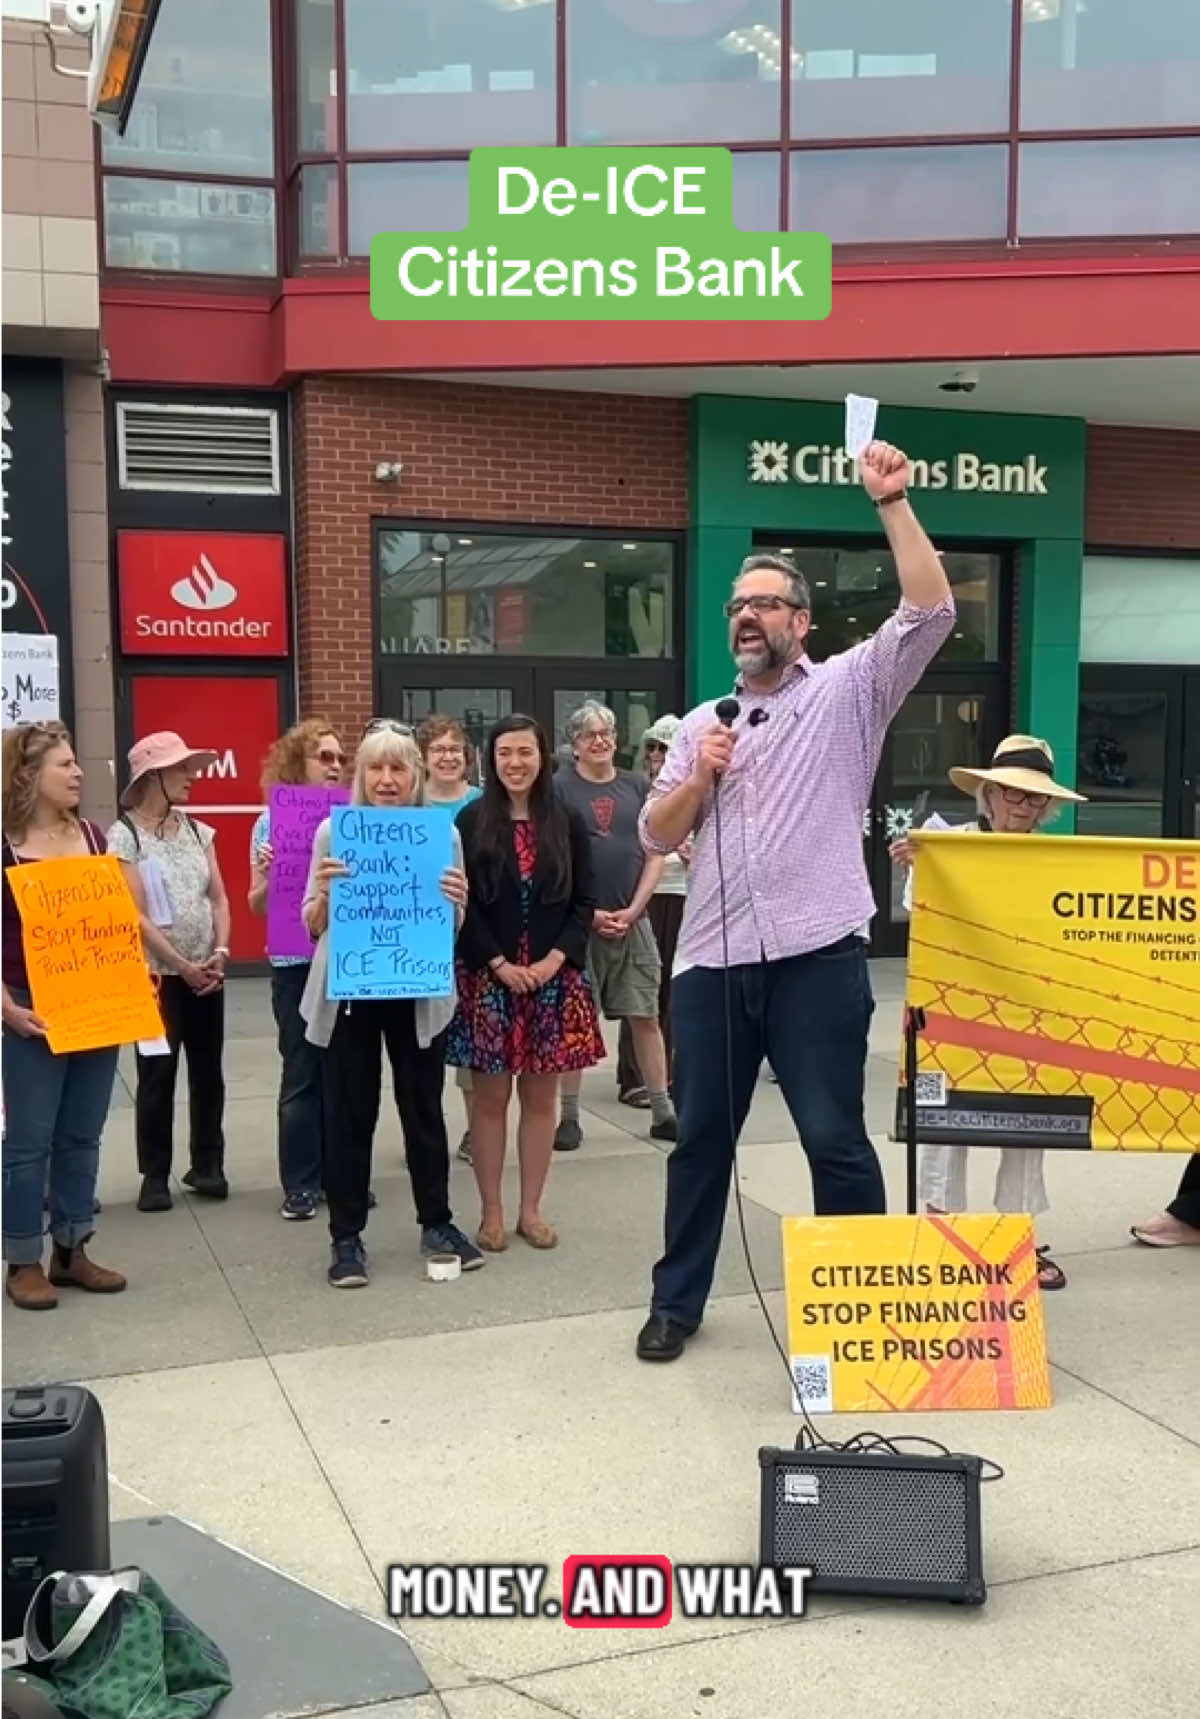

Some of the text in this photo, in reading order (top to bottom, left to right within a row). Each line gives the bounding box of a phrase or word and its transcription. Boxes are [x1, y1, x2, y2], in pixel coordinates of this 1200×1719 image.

[795, 444, 1049, 493] Citns Bank
[136, 615, 272, 638] Santander
[1052, 890, 1197, 923] CITIZENS
[370, 923, 404, 945] NOT
[1062, 929, 1196, 945] STOP THE FINANCING
[335, 948, 377, 980] ICE
[811, 1263, 1013, 1288] CITIZENS BANK
[802, 1299, 1026, 1325] STOP FINANCING
[832, 1337, 1003, 1363] ICE PRISONS
